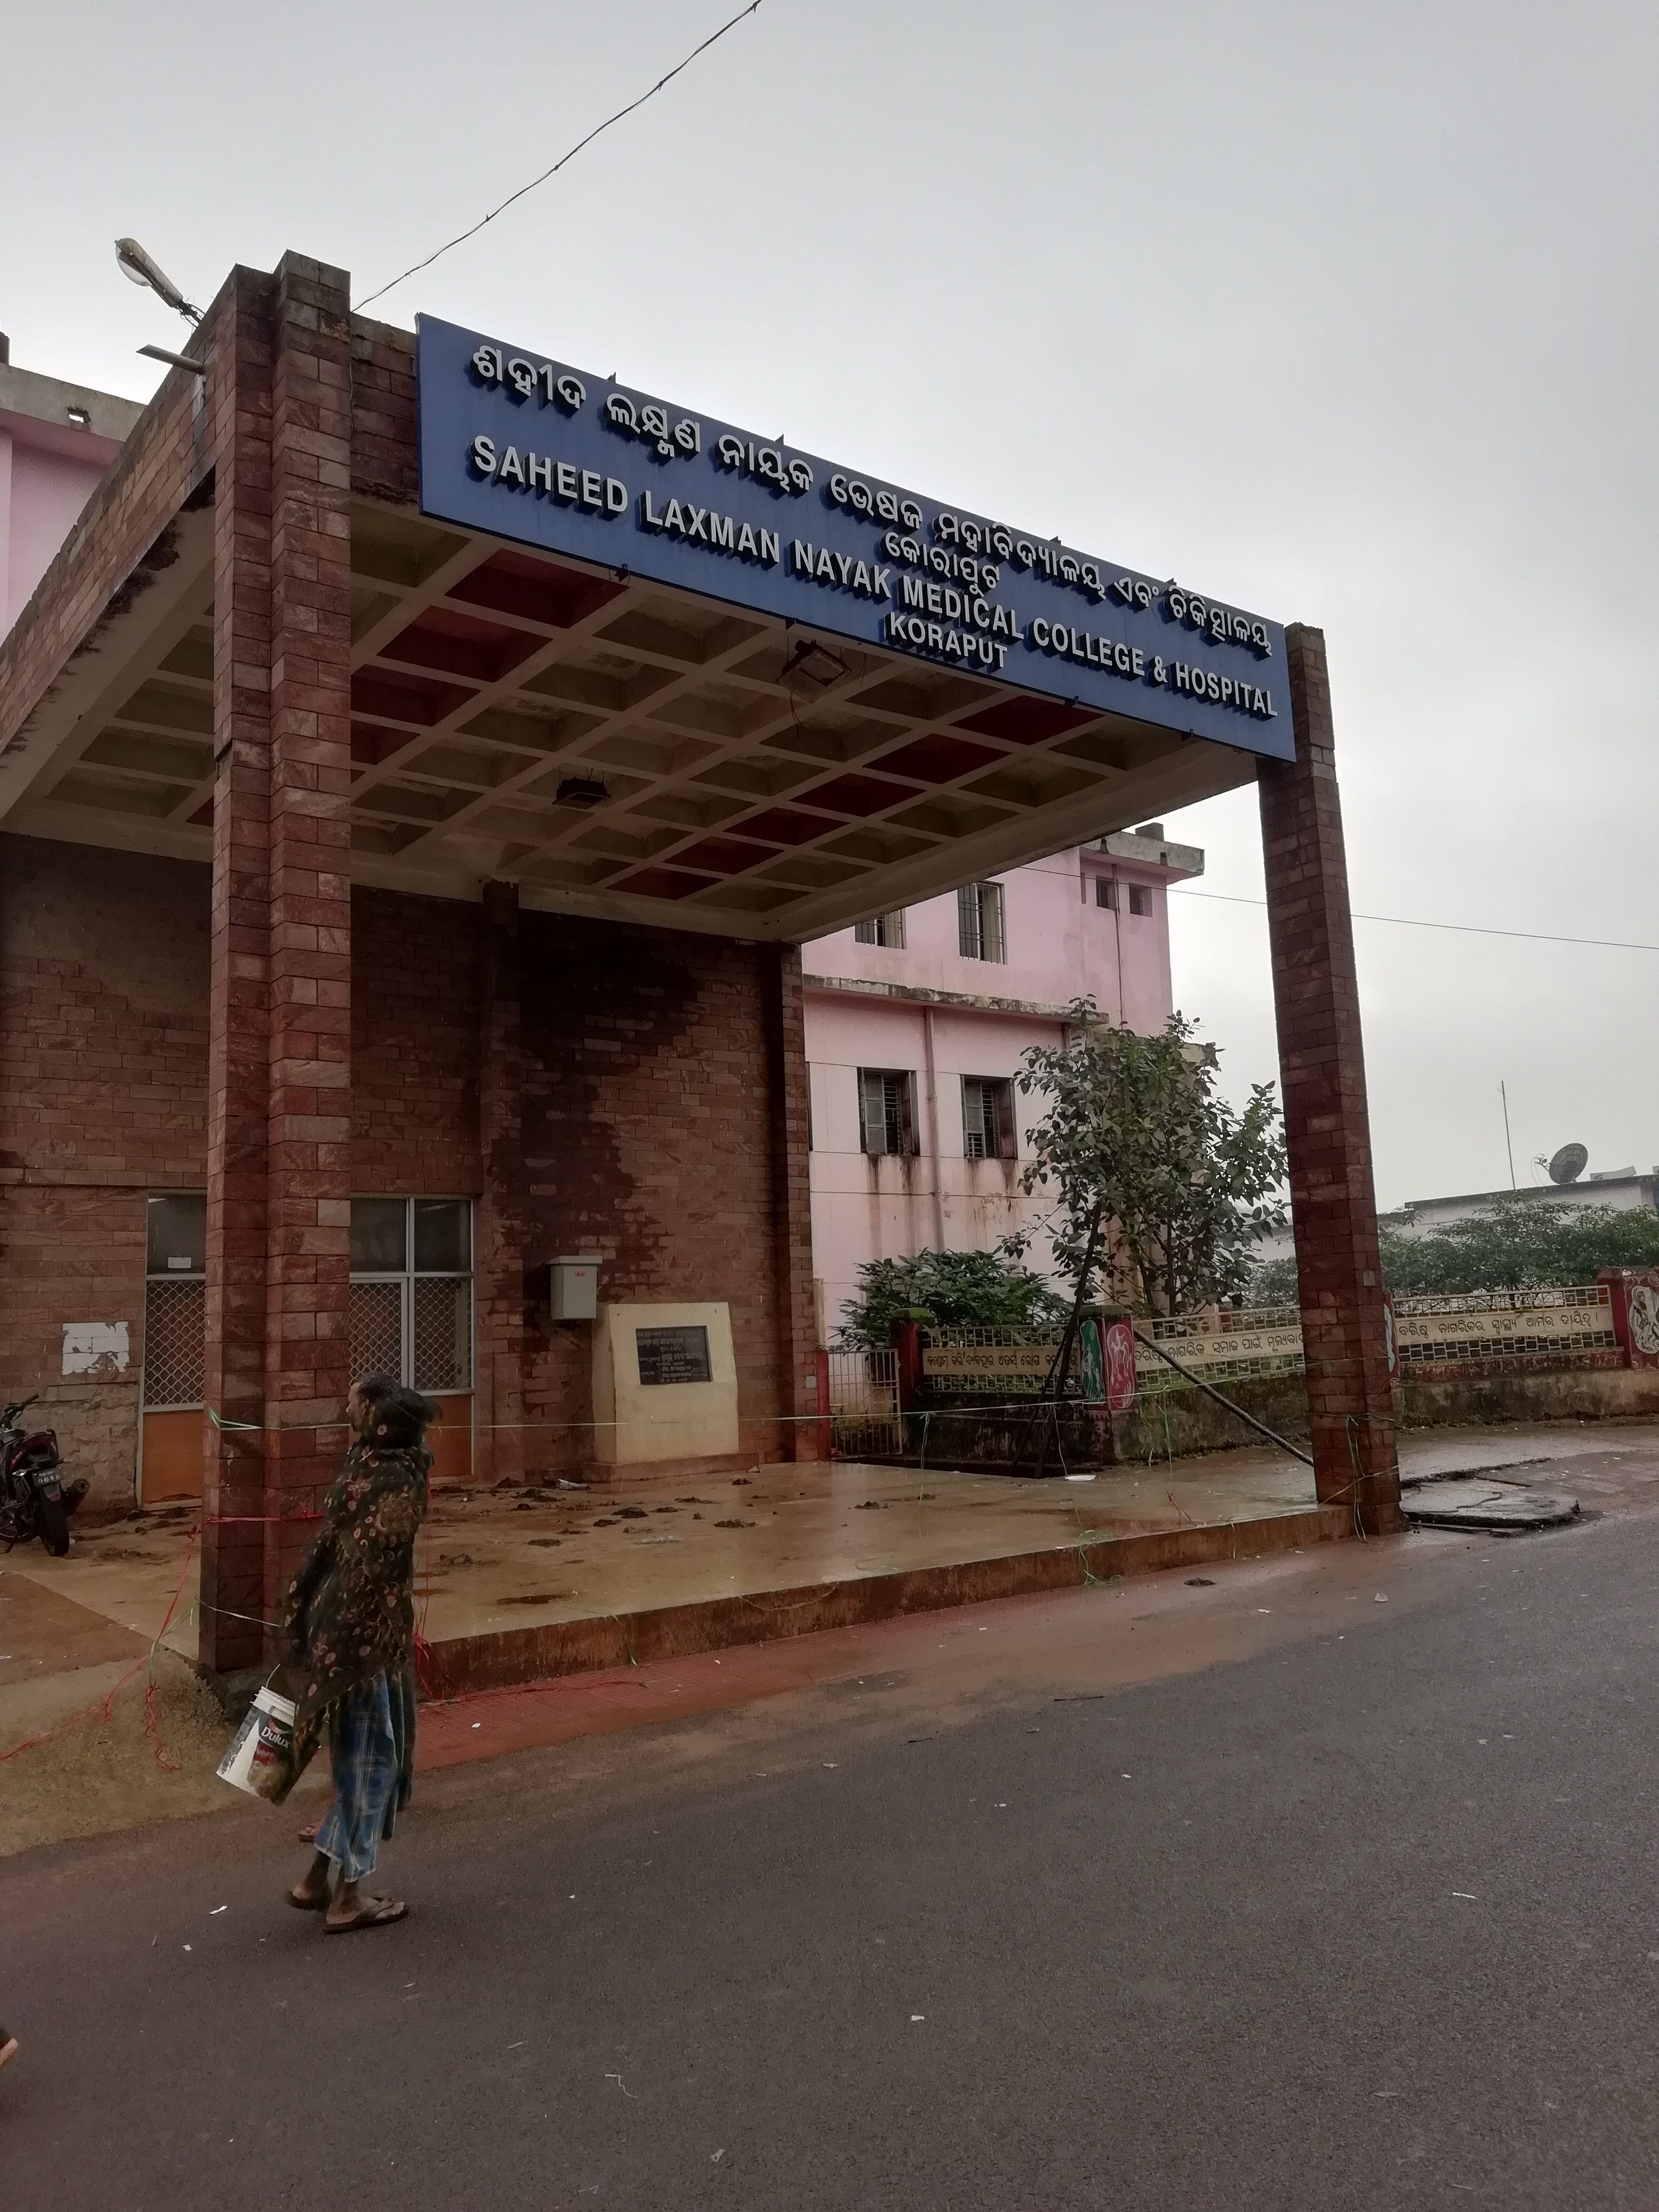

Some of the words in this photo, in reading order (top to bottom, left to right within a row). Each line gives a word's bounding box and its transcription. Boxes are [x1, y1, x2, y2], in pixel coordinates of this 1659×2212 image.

[473, 345, 586, 409] ଶହୀଦ
[718, 434, 814, 491] ନାୟକ
[831, 474, 923, 529] ଭେଷଜ
[939, 513, 1106, 600] ମହାବିଦ୍ୟାଳୟ
[1113, 577, 1160, 607] ଏବଂ
[474, 435, 628, 512] SAHEED
[645, 490, 780, 563] LAXMAN
[795, 539, 892, 598] NAYAK
[903, 574, 1024, 640] MEDICAL
[1033, 617, 1145, 676] COLLEGE
[1154, 655, 1168, 683] &
[1176, 661, 1278, 716] HOSPITAL
[885, 532, 1000, 598] କୋରାପୁଟ
[890, 611, 1008, 668] KORAPUT
[261, 1727, 290, 1749] Dulux
